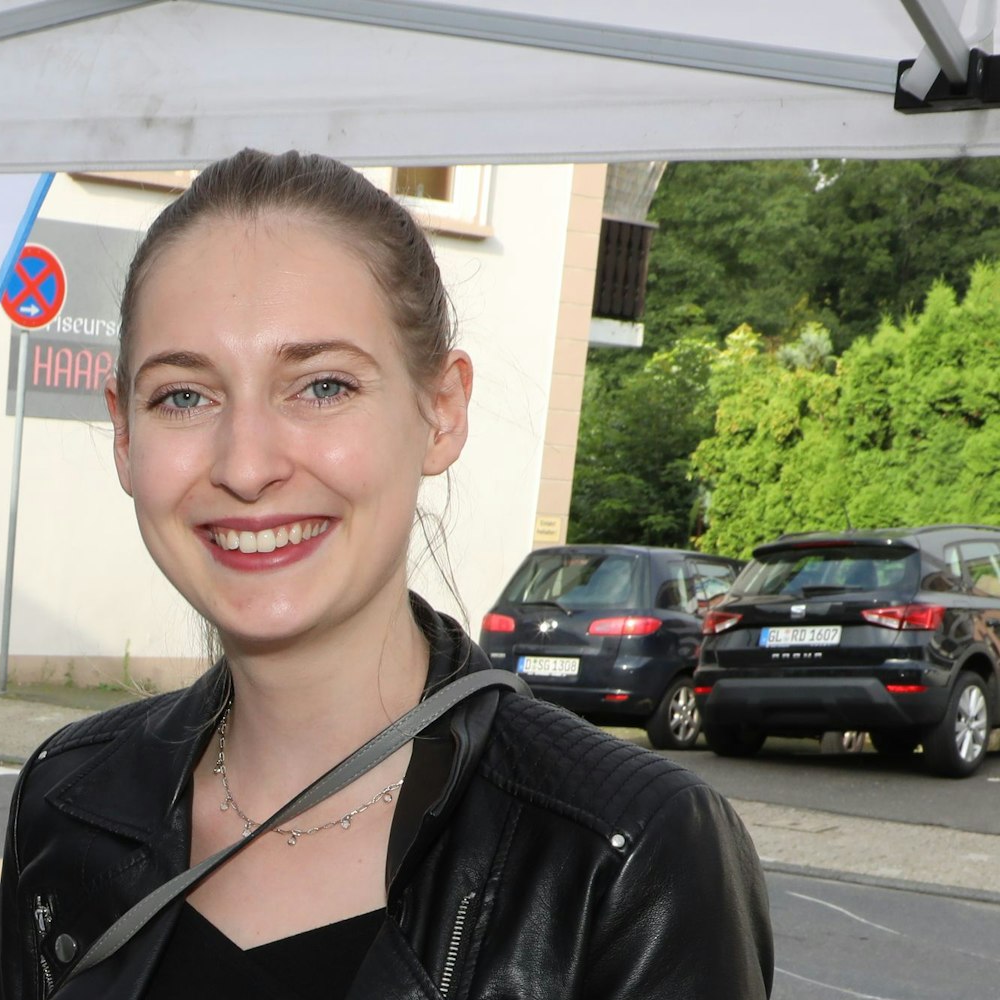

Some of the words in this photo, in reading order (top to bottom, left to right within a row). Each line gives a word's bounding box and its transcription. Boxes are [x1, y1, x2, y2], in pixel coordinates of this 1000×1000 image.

[769, 630, 782, 642] GL
[791, 629, 807, 641] RD
[809, 628, 839, 641] 1607
[525, 659, 532, 670] D
